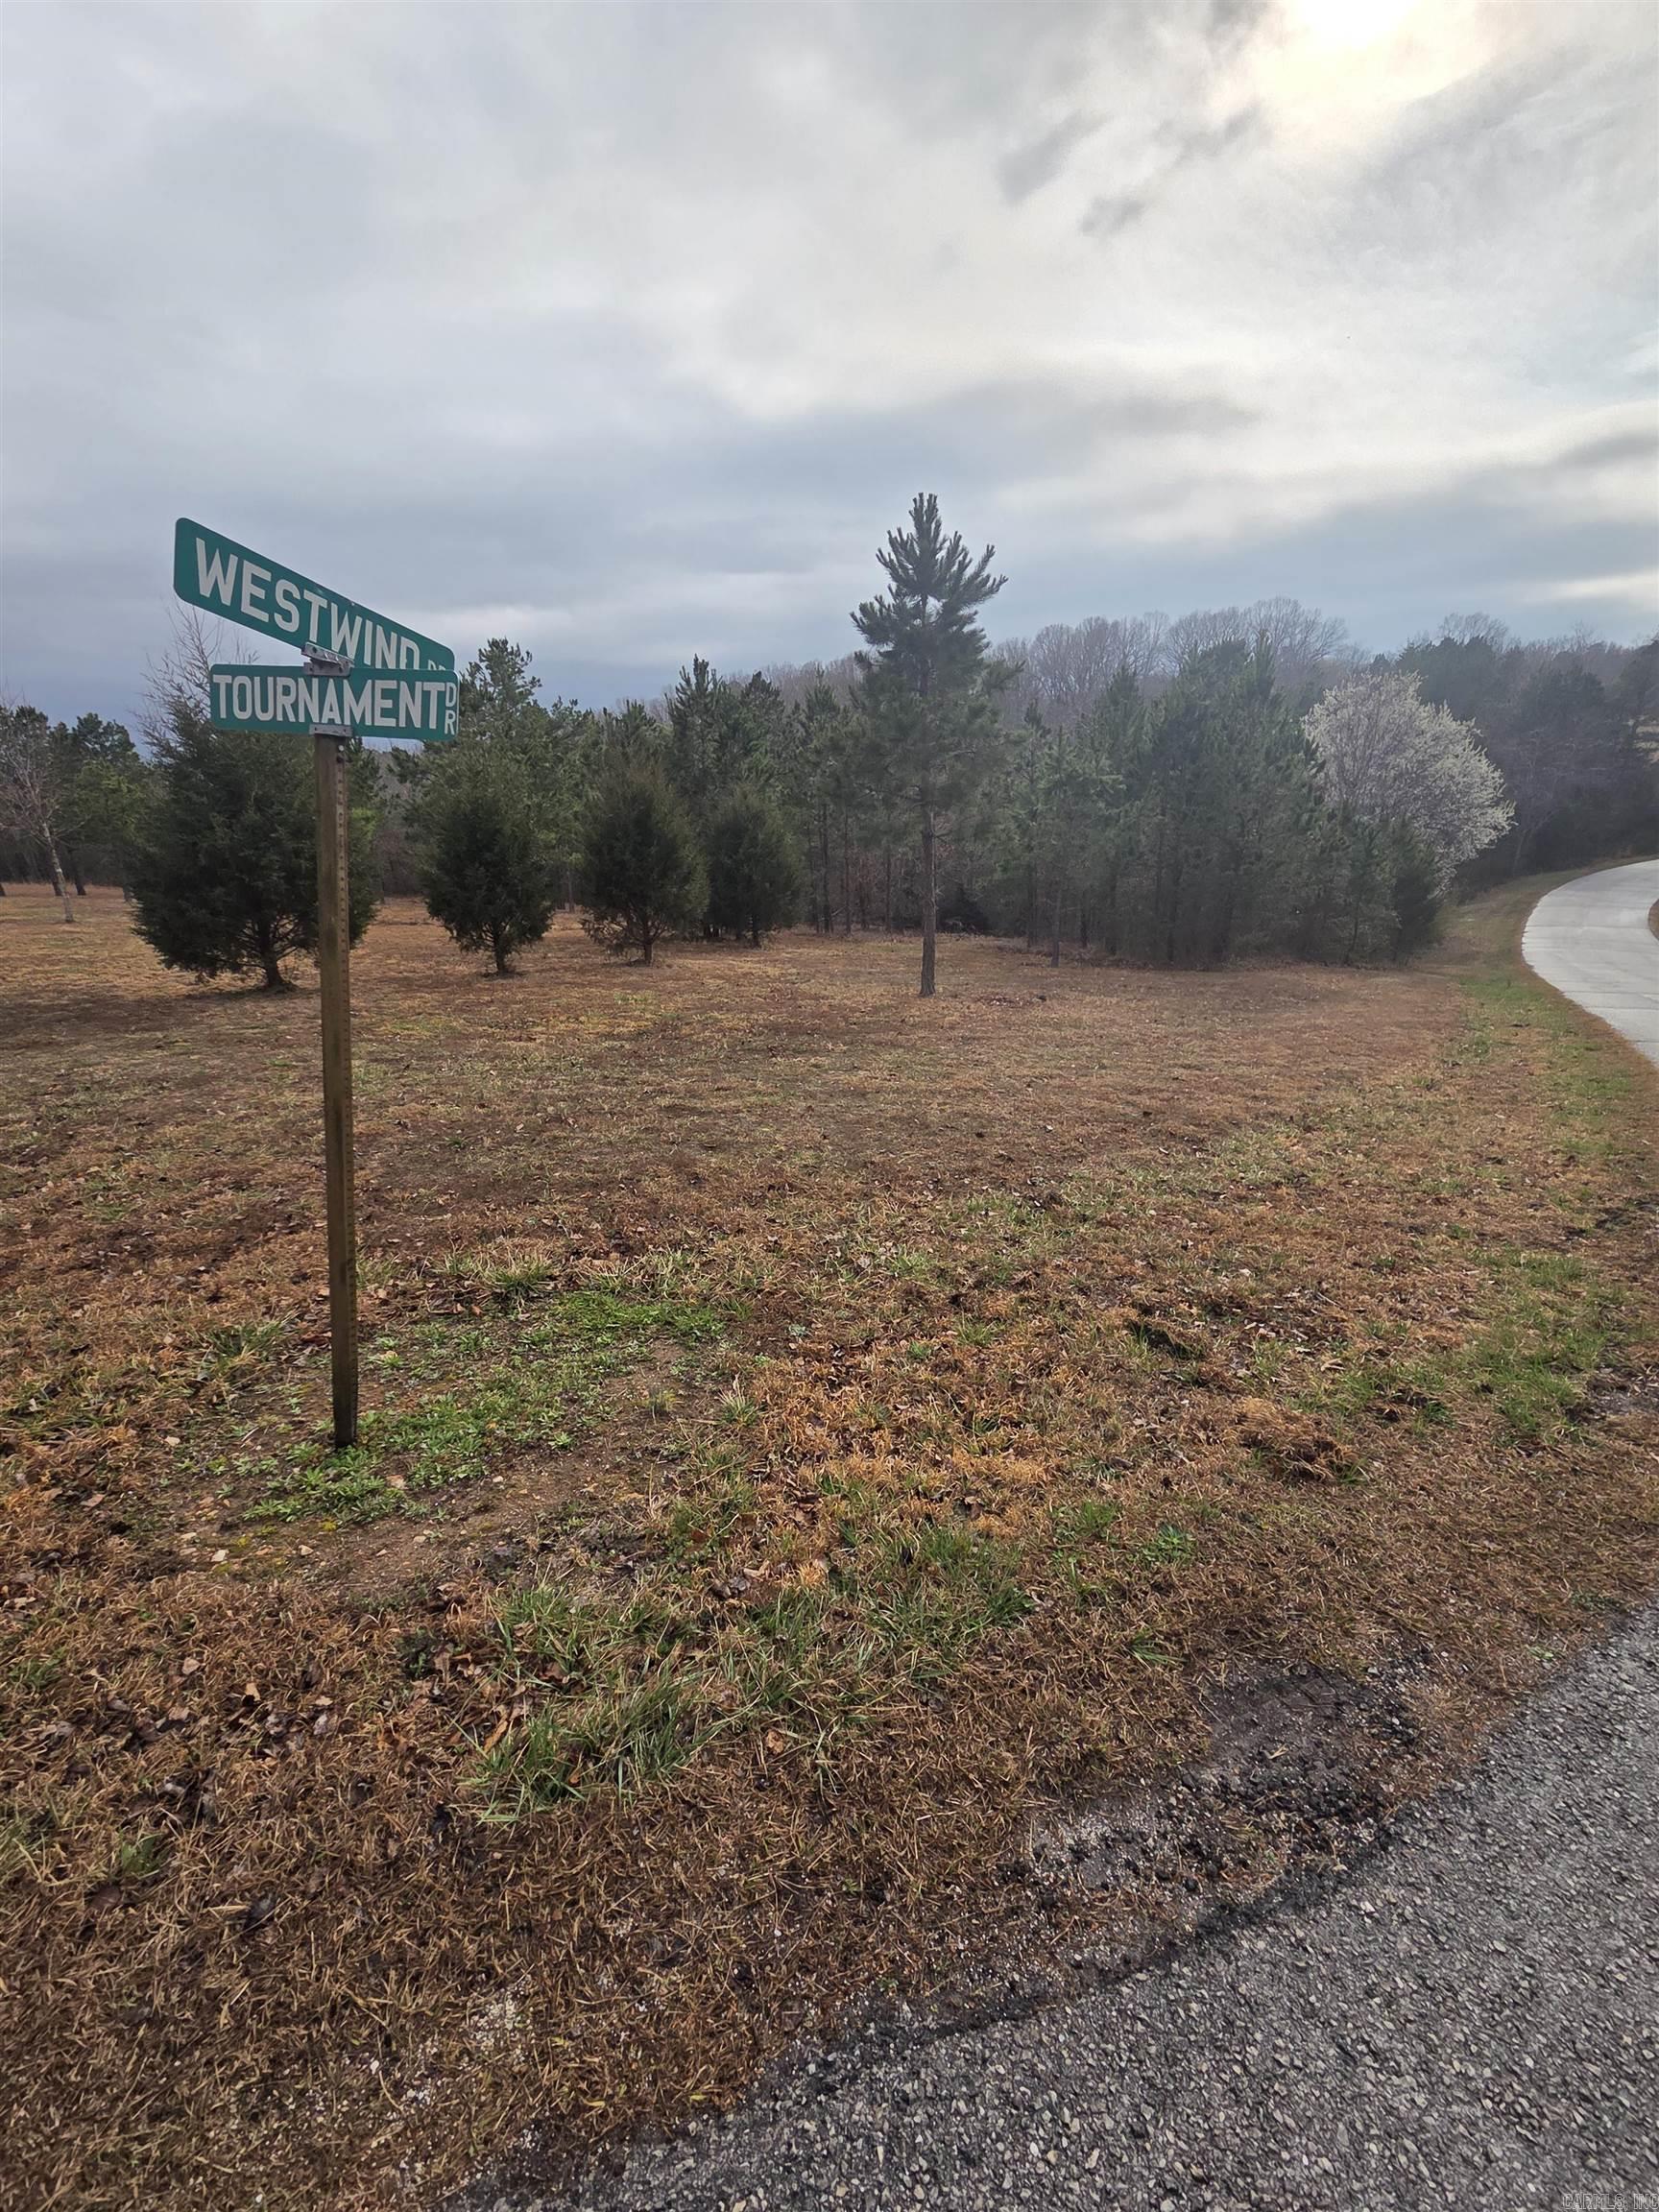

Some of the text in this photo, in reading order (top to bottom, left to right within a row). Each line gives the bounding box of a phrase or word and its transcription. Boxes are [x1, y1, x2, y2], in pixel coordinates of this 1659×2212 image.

[195, 537, 421, 670] WESTWIND
[212, 674, 457, 735] TOURNAMENT DR
